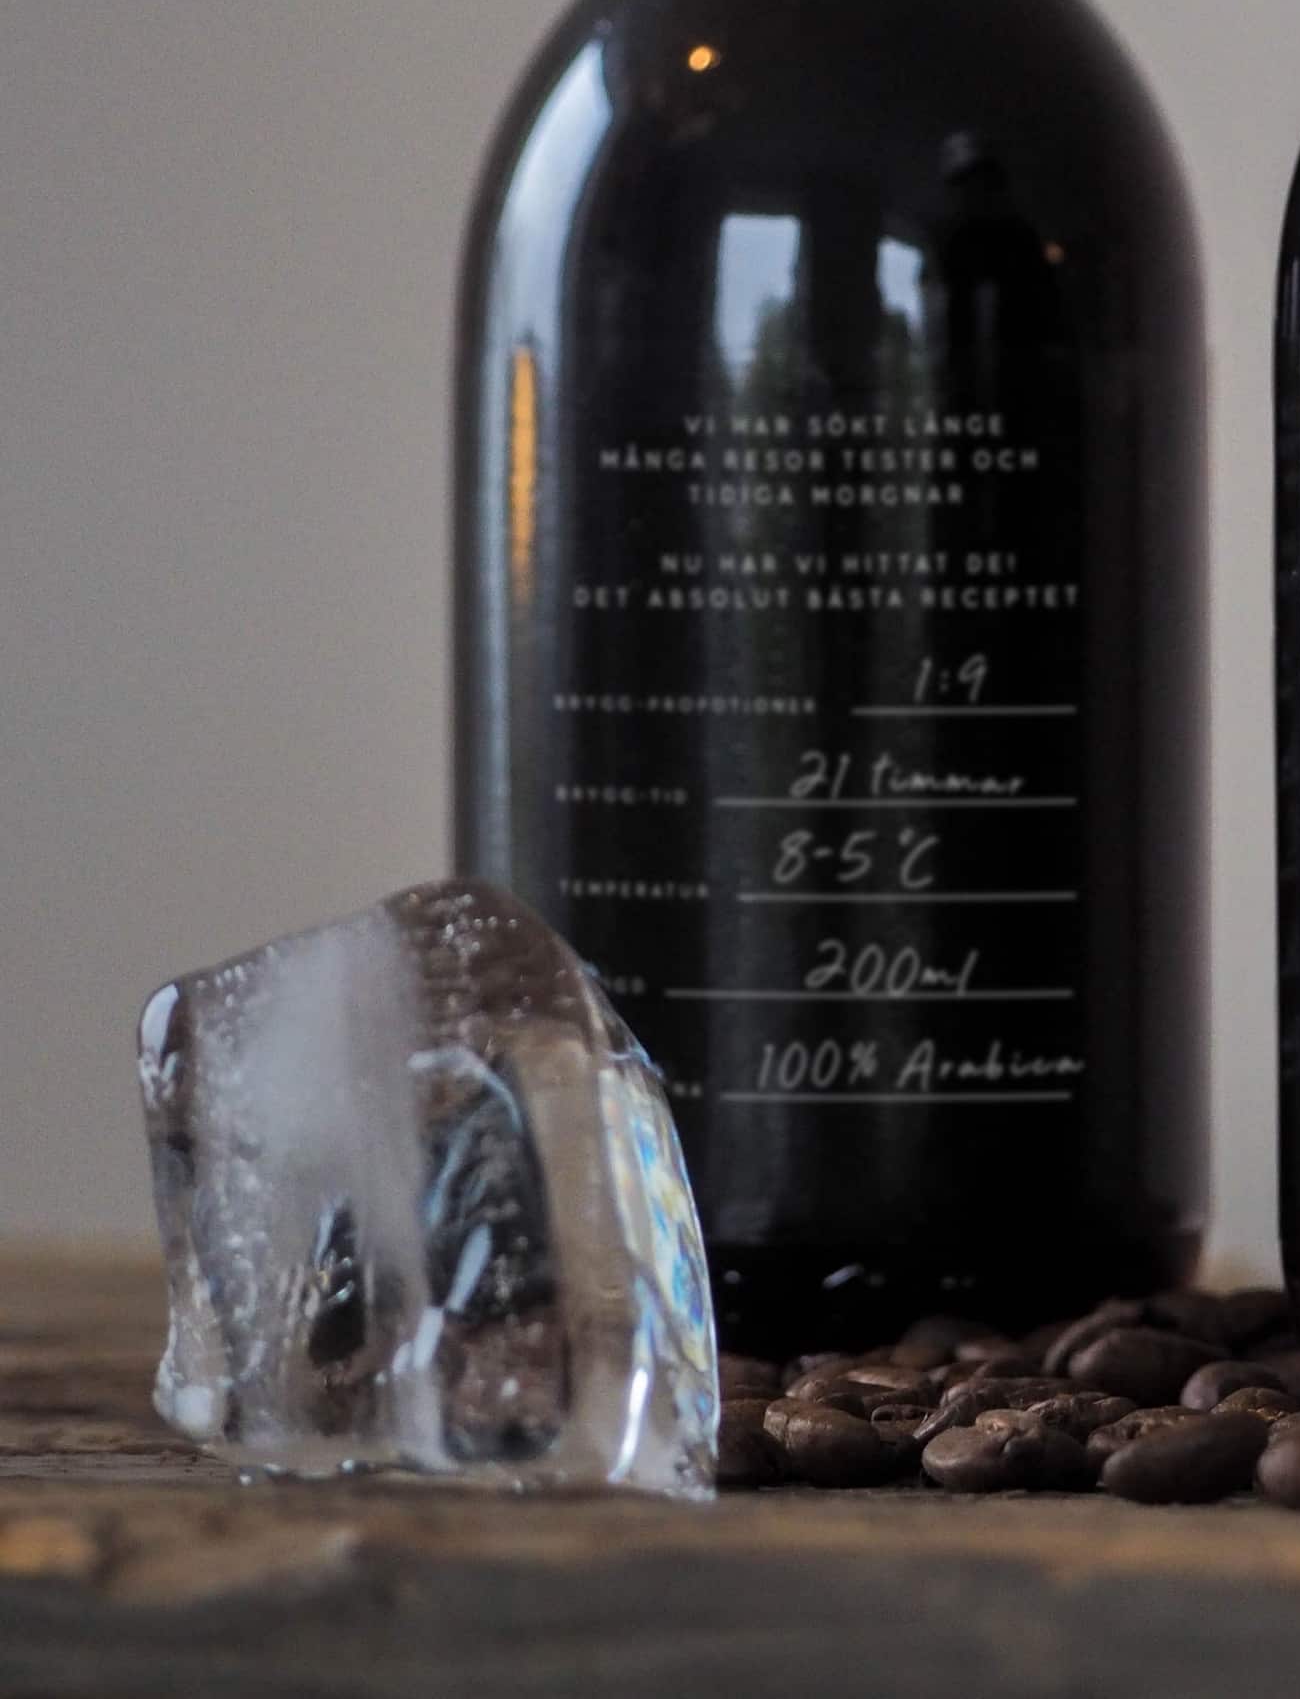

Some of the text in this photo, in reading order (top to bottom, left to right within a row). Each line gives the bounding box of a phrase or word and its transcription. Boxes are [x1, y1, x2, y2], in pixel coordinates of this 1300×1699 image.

[685, 416, 715, 435] VI
[731, 416, 791, 436] HAR
[724, 450, 825, 471] RESOR
[843, 450, 957, 471] TESTER
[972, 450, 1039, 471] OCH
[688, 484, 964, 505] TIDIGA MORGNAR
[660, 553, 701, 574] NU
[720, 553, 777, 574] HAR
[796, 553, 826, 574] VI
[843, 553, 947, 574] HITTAT
[572, 587, 628, 609] DET
[647, 587, 791, 610] ABSOLUT
[920, 585, 1078, 610] RECEPTET
[914, 654, 987, 702] 1:9
[789, 750, 850, 800] 21
[757, 1039, 878, 1090] 100%
